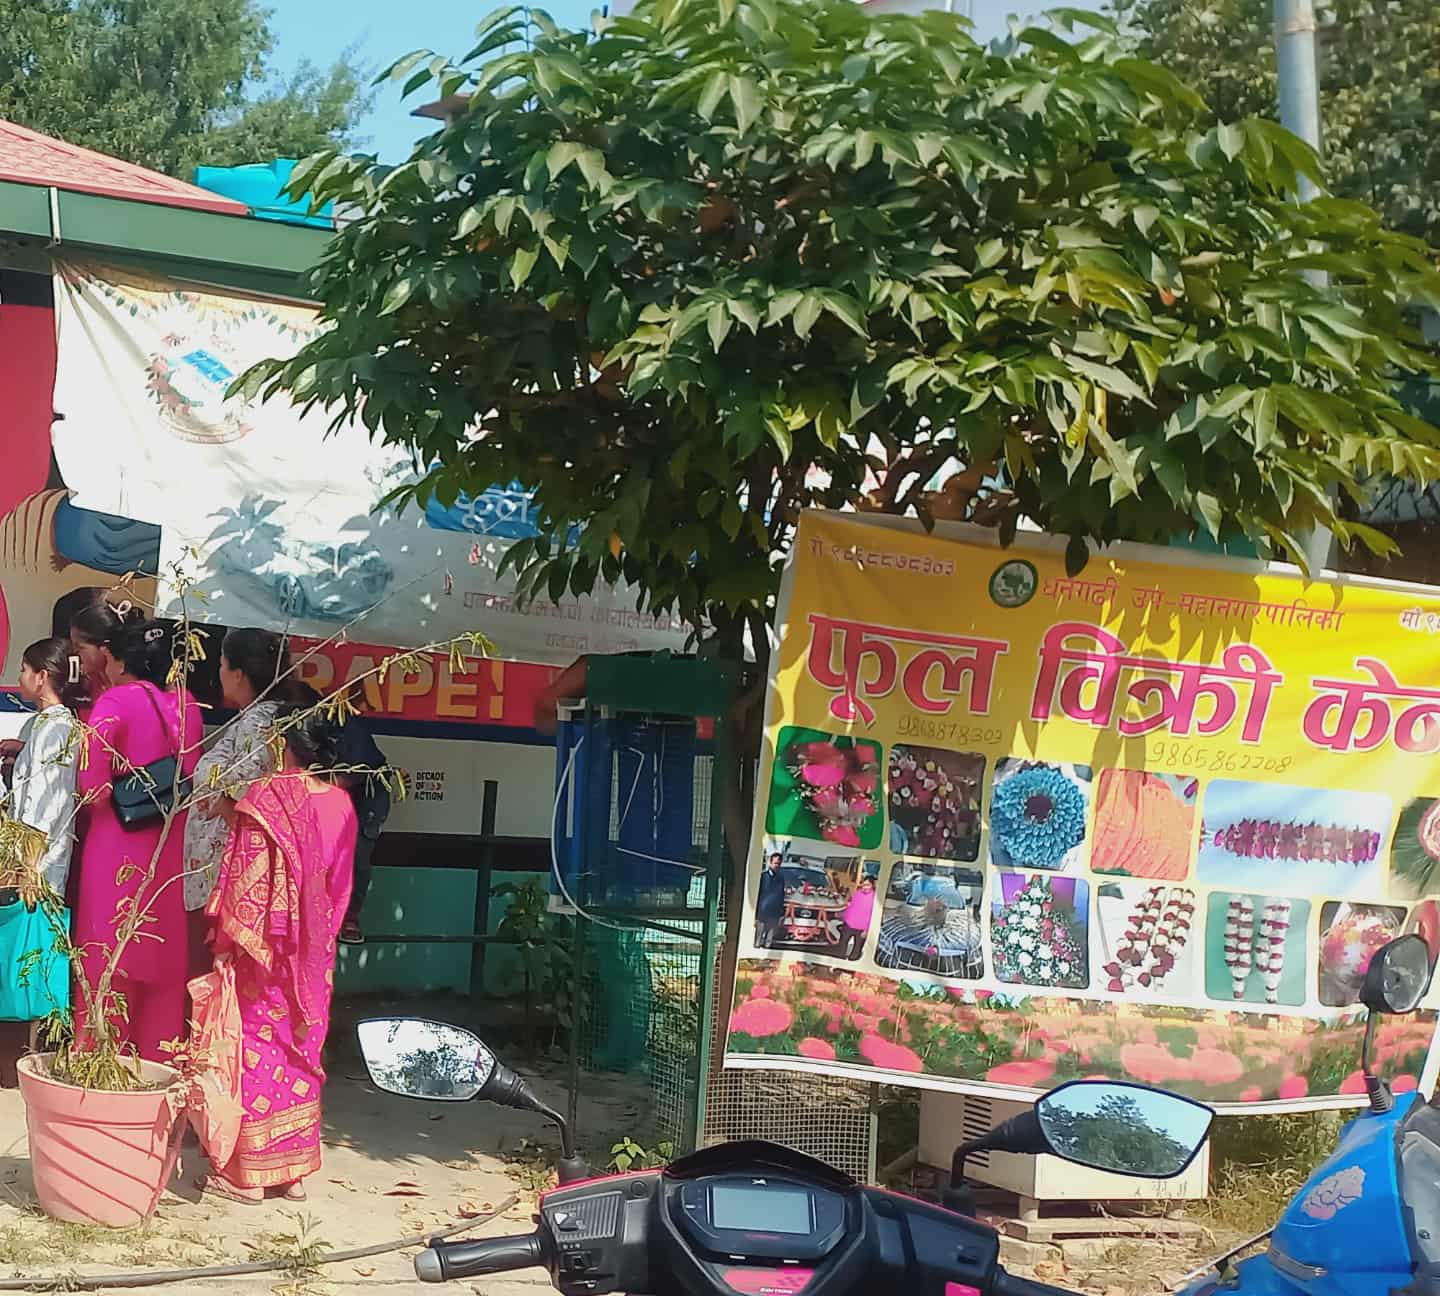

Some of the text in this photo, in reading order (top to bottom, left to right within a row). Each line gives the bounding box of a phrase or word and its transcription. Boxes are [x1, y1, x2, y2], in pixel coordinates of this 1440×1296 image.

[808, 614, 1009, 729] फूल
[1030, 620, 1284, 743] विक्री
[416, 772, 445, 781] DECADE
[415, 792, 444, 800] ACTION
